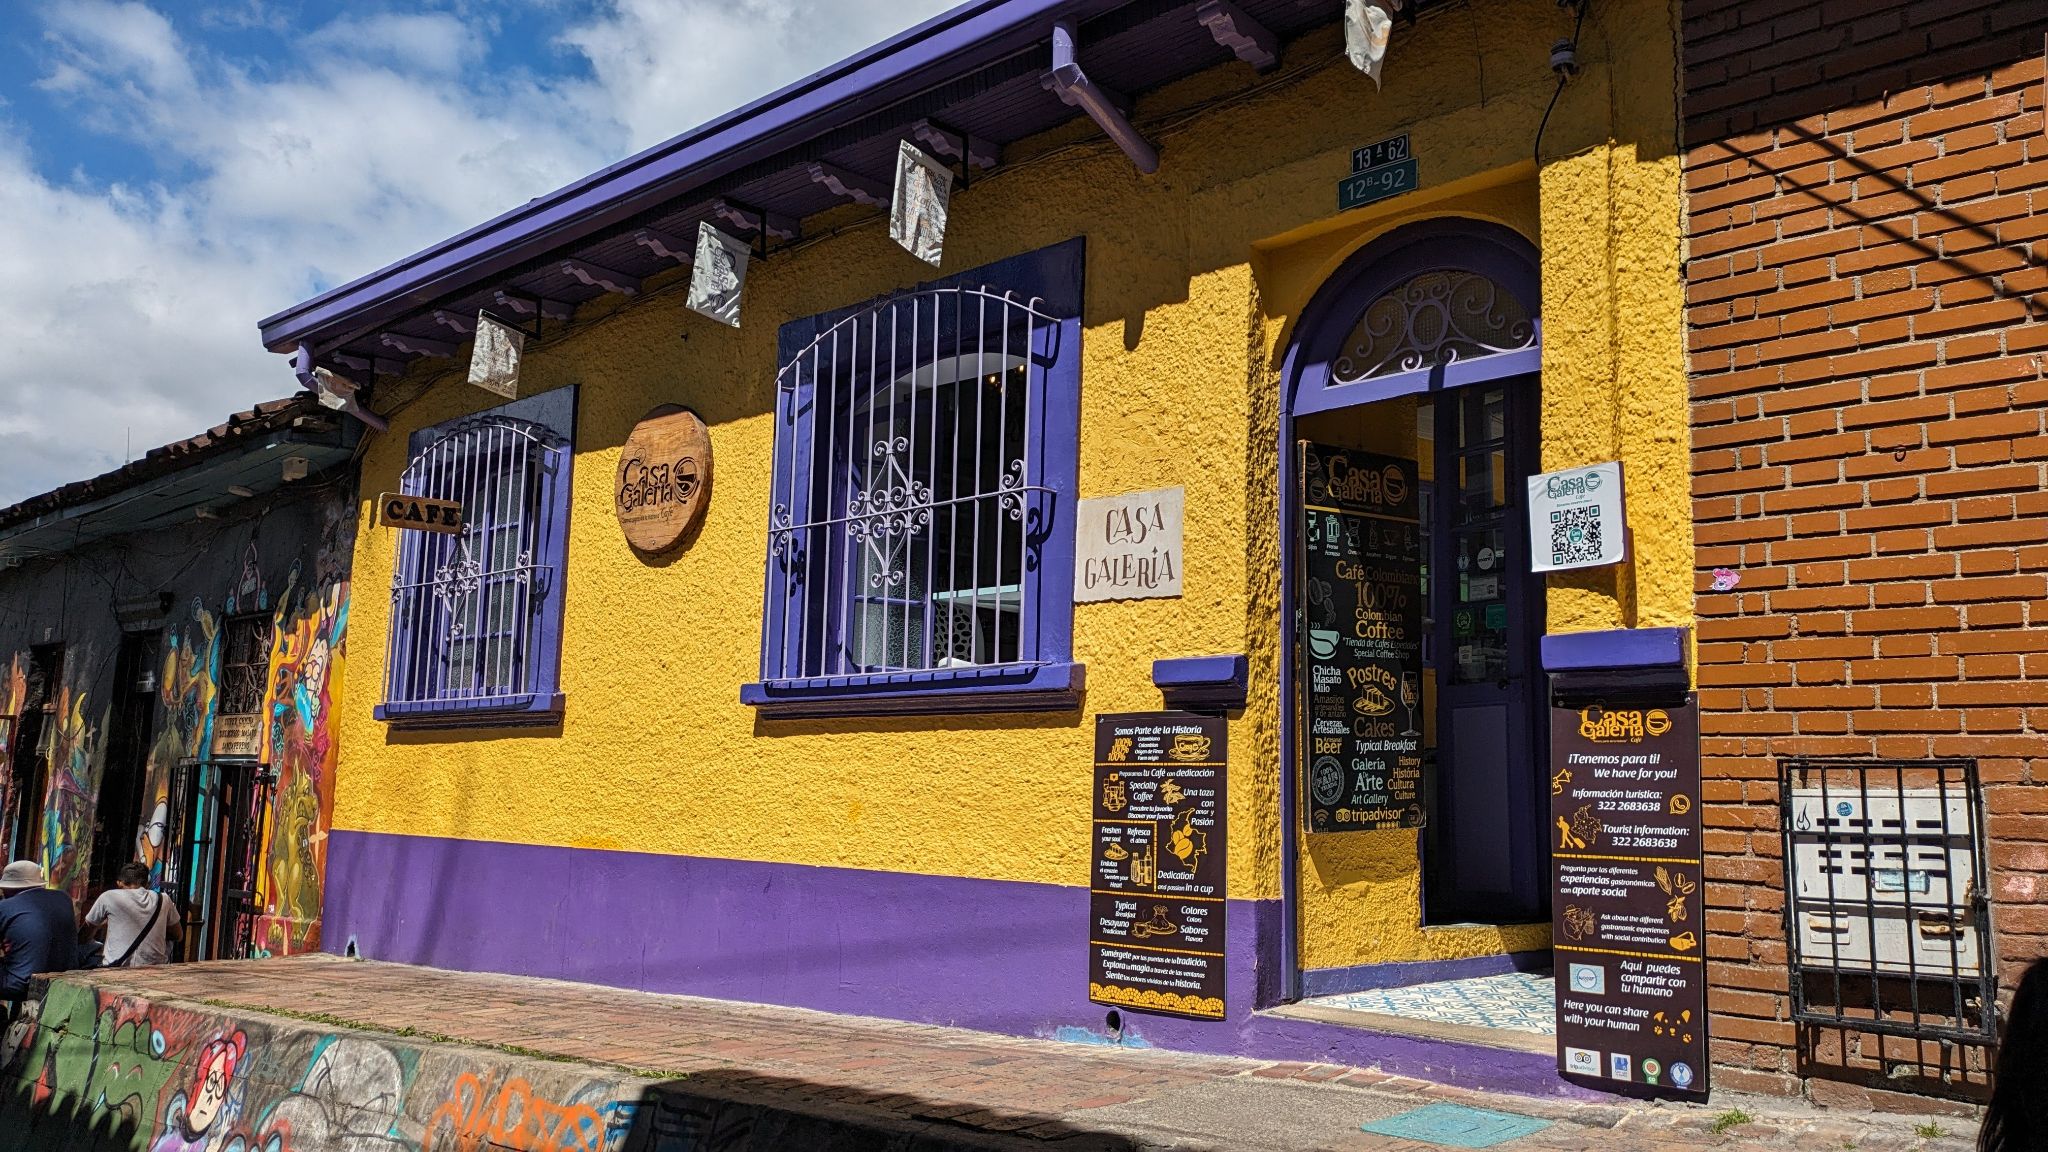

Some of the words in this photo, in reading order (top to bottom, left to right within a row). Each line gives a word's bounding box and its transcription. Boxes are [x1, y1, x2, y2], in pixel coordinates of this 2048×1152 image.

[1356, 149, 1371, 169] 13
[1388, 138, 1405, 160] 62
[622, 456, 670, 486] Casa
[1328, 455, 1380, 490] Casa
[1547, 475, 1584, 492] Casa
[386, 500, 458, 527] CAFE
[1105, 502, 1165, 545] CASA
[1336, 560, 1365, 580] Café
[1355, 582, 1406, 609] 100%
[1356, 608, 1402, 622] Colombian
[1356, 620, 1404, 640] Coffee
[1354, 649, 1374, 659] Special
[1376, 650, 1394, 658] Coffee
[1313, 665, 1341, 676] Chicha
[1314, 674, 1342, 684] Masato
[1347, 664, 1397, 690] Postres
[1314, 684, 1330, 693] Milo
[1579, 705, 1642, 727] Casa
[1316, 718, 1342, 728] Cervezas
[1354, 717, 1395, 738] Cakes
[1114, 727, 1134, 736] Somos
[1134, 726, 1152, 735] Parte
[1152, 726, 1162, 734] de
[1163, 726, 1170, 734] la
[1172, 726, 1202, 734] Historia
[1312, 725, 1350, 734] Artesanales
[1315, 738, 1342, 754] Beer
[1356, 740, 1382, 754] Typical
[1384, 739, 1417, 754] Breakfast
[1352, 758, 1386, 770] Galería
[1398, 756, 1420, 768] History
[1621, 756, 1646, 767] para
[1649, 754, 1660, 764] ti!
[1151, 768, 1166, 778] Café
[1176, 768, 1214, 777] dedicación
[1594, 768, 1610, 778] We
[1612, 768, 1636, 778] have
[1637, 768, 1653, 780] for
[1654, 769, 1678, 781] you!
[1355, 773, 1384, 792] Arte
[1388, 779, 1414, 790] Cultura
[1134, 792, 1154, 802] Coffee
[1184, 788, 1198, 796] Una
[1572, 788, 1624, 800] Información
[1201, 800, 1214, 808] con
[1351, 794, 1362, 805] Art
[1598, 802, 1616, 810] 322
[1618, 802, 1661, 812] 2683638
[1191, 817, 1214, 826] Pasión
[1352, 807, 1401, 824] tripadvisor
[1127, 828, 1151, 837] Refresca
[1603, 824, 1632, 834] Tourist
[1612, 837, 1630, 846] 322
[1633, 837, 1678, 848] 2683638
[1158, 870, 1194, 880] Dedication
[1560, 875, 1610, 885] experiencias
[1200, 886, 1214, 894] cup
[1572, 887, 1600, 896] aporte
[1602, 888, 1627, 897] social
[1115, 901, 1137, 911] Typical
[1181, 906, 1208, 916] Colores
[1180, 925, 1208, 936] Sabores
[1101, 948, 1131, 960] Sumérgete
[1646, 963, 1681, 975] puedes
[1621, 974, 1666, 988] compartir
[1668, 978, 1686, 988] con
[1621, 984, 1630, 992] tu
[1632, 985, 1673, 997] humano
[1564, 1000, 1584, 1011] Here
[1586, 1004, 1602, 1015] you
[1604, 1006, 1621, 1015] can
[1623, 1007, 1649, 1018] share
[1564, 1014, 1582, 1024] with
[1584, 1017, 1605, 1028] your
[1607, 1017, 1640, 1032] human
